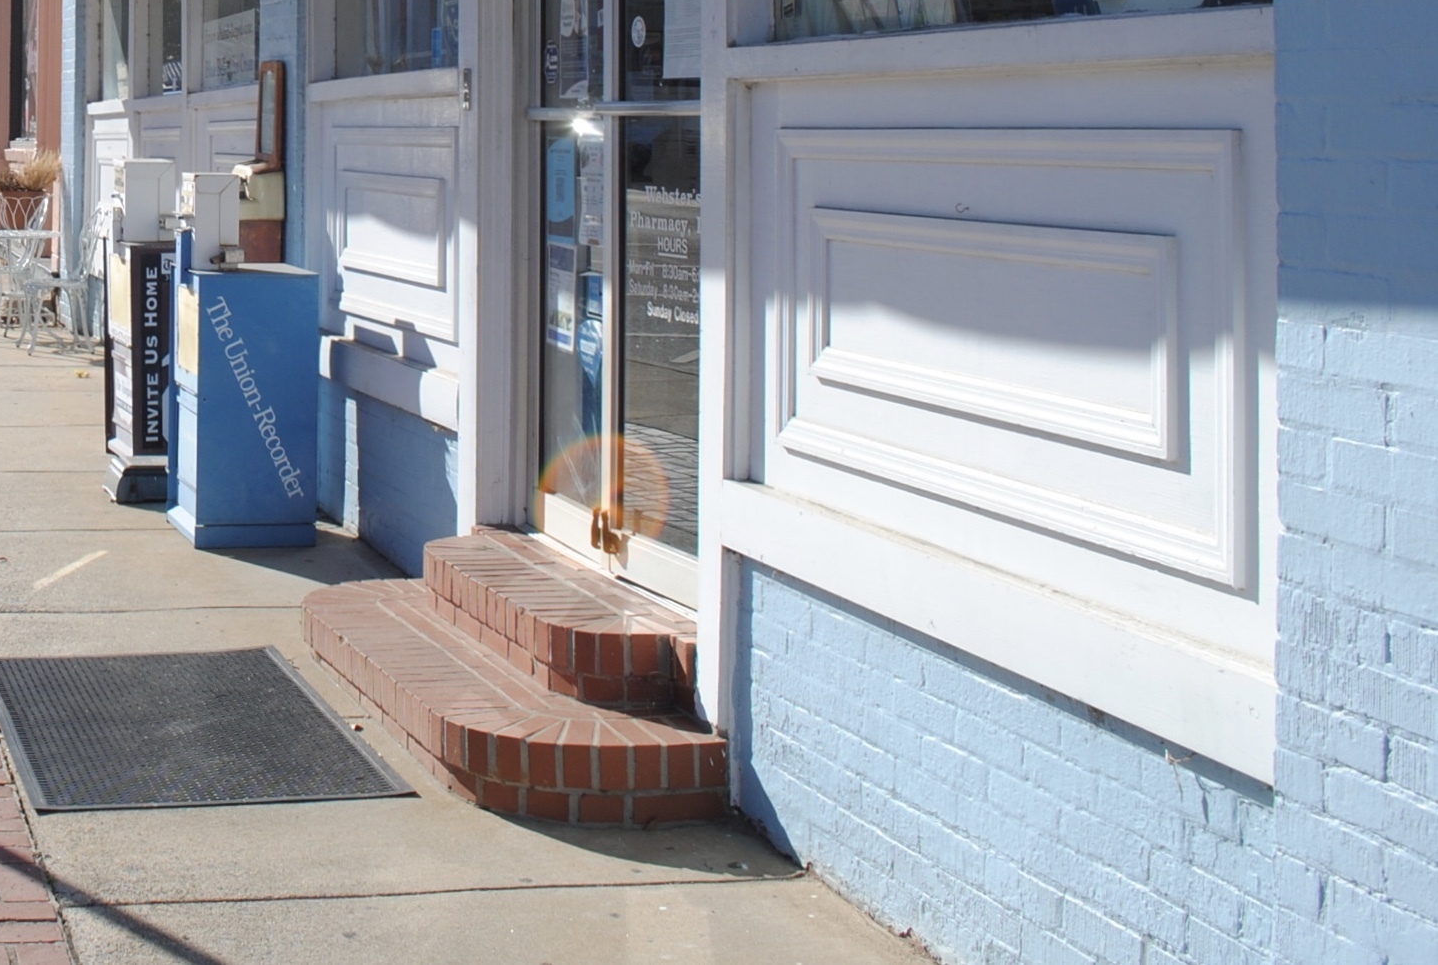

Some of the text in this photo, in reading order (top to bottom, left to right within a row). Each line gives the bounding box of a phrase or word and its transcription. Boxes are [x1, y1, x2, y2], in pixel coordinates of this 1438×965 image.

[645, 186, 701, 207] Webster's
[629, 210, 691, 237] Pharmacy,
[657, 236, 688, 254] HOURS
[629, 278, 659, 300] Saturday
[647, 301, 699, 325] Sunday Closed
[144, 266, 159, 442] INVITE US HOME
[205, 296, 305, 500] The Union-Recorder
